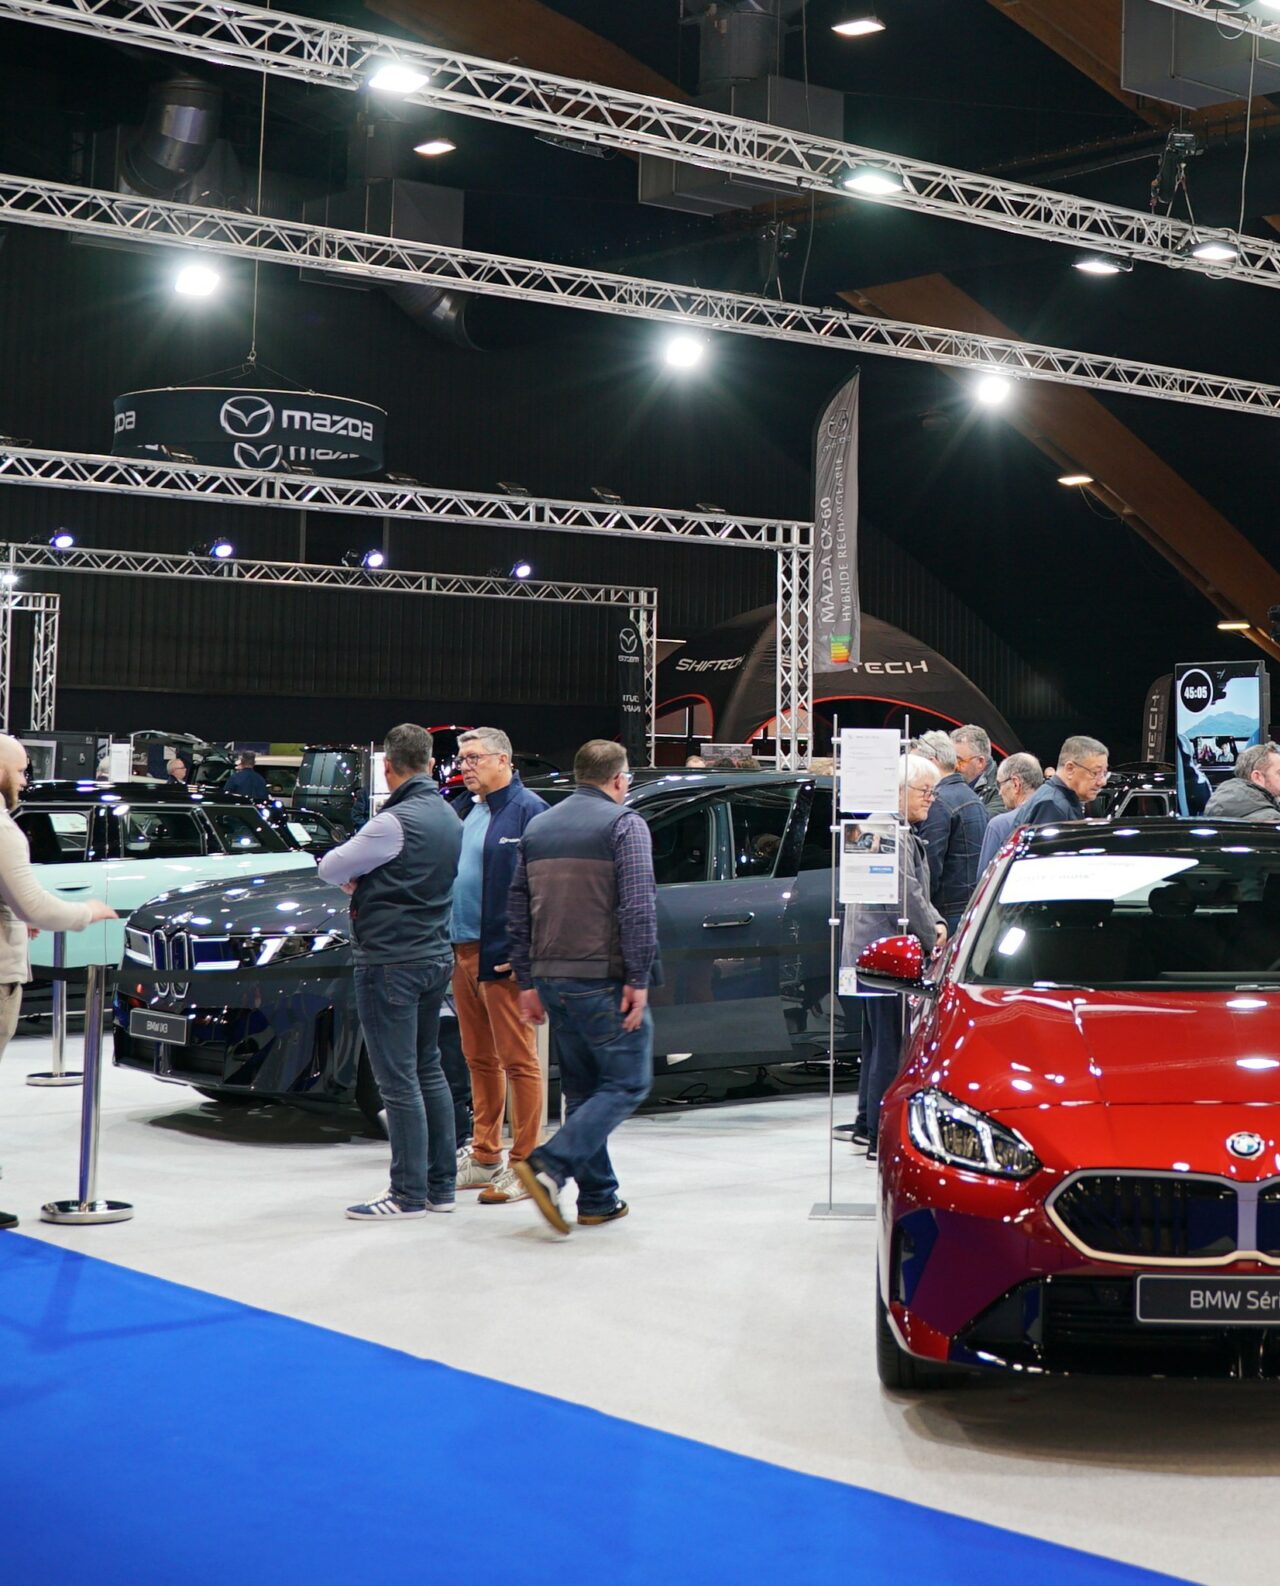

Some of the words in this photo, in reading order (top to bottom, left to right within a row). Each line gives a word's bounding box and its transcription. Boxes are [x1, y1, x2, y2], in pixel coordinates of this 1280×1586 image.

[282, 409, 374, 441] mazda
[820, 496, 833, 551] CX-60
[820, 554, 836, 624] MAZDA
[841, 562, 851, 623] HYBRIDE
[675, 654, 745, 672] SHIFTECH
[1183, 685, 1208, 699] 45:05
[1189, 1290, 1242, 1309] BMW
